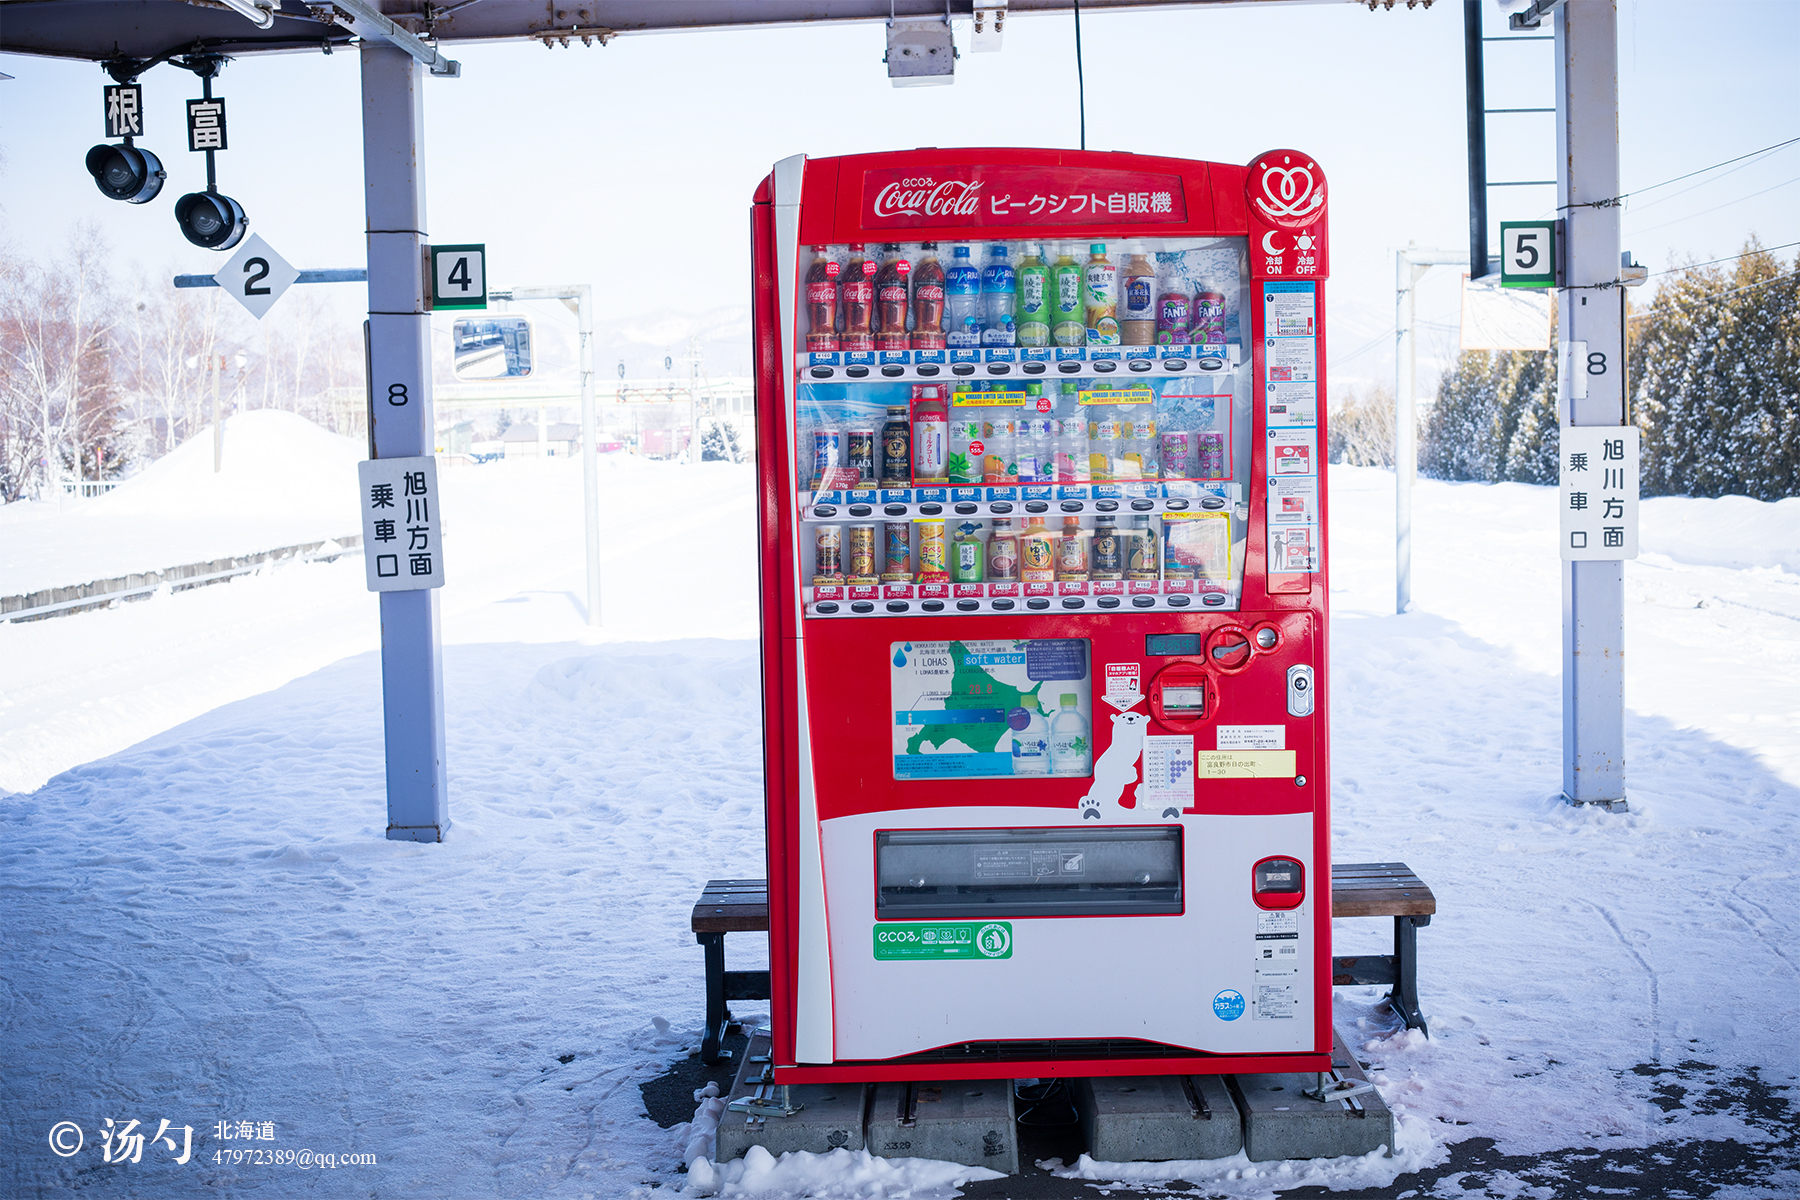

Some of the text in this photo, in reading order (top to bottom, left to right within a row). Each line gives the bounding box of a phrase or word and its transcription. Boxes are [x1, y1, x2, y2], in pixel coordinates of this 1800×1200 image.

[106, 88, 141, 136] 根
[188, 101, 222, 149] 富
[874, 180, 985, 218] Coca-Cola
[990, 191, 1173, 214] ピークシフト自販機
[1265, 256, 1283, 265] 冷却
[1297, 256, 1315, 265] 冷却
[1514, 234, 1540, 269] 5
[243, 255, 272, 297] 2
[447, 256, 472, 292] 4
[1266, 266, 1282, 274] ON
[1296, 266, 1316, 274] OFF
[1586, 352, 1607, 376] 8
[387, 383, 409, 407] 8
[850, 459, 873, 468] BLACK
[1568, 452, 1589, 550] 乗車口
[1602, 438, 1625, 548] 旭川方面
[370, 484, 399, 579] 乗車口
[403, 470, 432, 578] 旭川方面
[1030, 545, 1040, 563] ゆず
[1152, 639, 1194, 651] 販売中
[922, 658, 948, 667] LOHAS
[954, 658, 962, 666] is
[965, 656, 989, 665] soft
[994, 655, 1022, 664] water
[968, 684, 993, 695] 28.8
